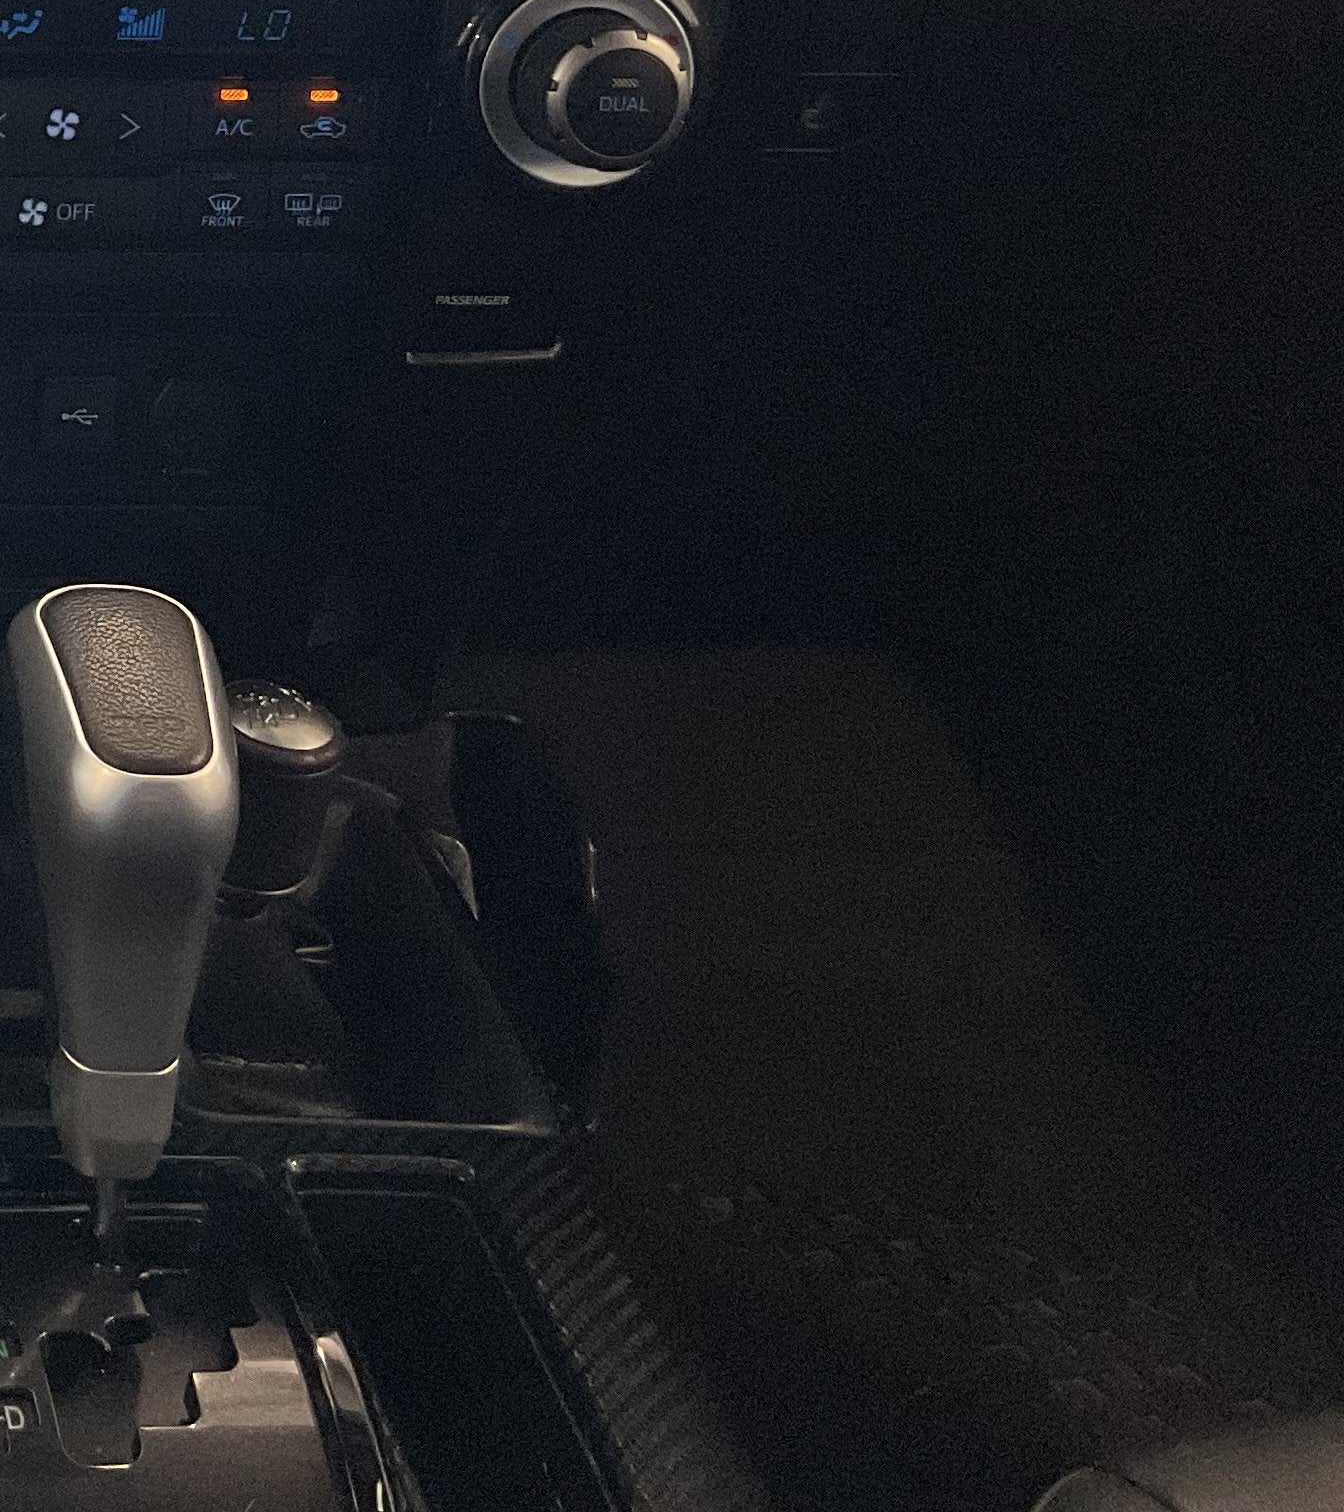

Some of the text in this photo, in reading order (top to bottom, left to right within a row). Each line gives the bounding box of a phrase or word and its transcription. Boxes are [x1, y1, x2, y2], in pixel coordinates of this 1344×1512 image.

[599, 95, 649, 113] DUAL
[215, 119, 254, 136] A/C
[56, 203, 95, 221] OFF
[201, 216, 244, 228] FRONT
[296, 216, 330, 228] REAR
[435, 295, 511, 306] PASSENGER
